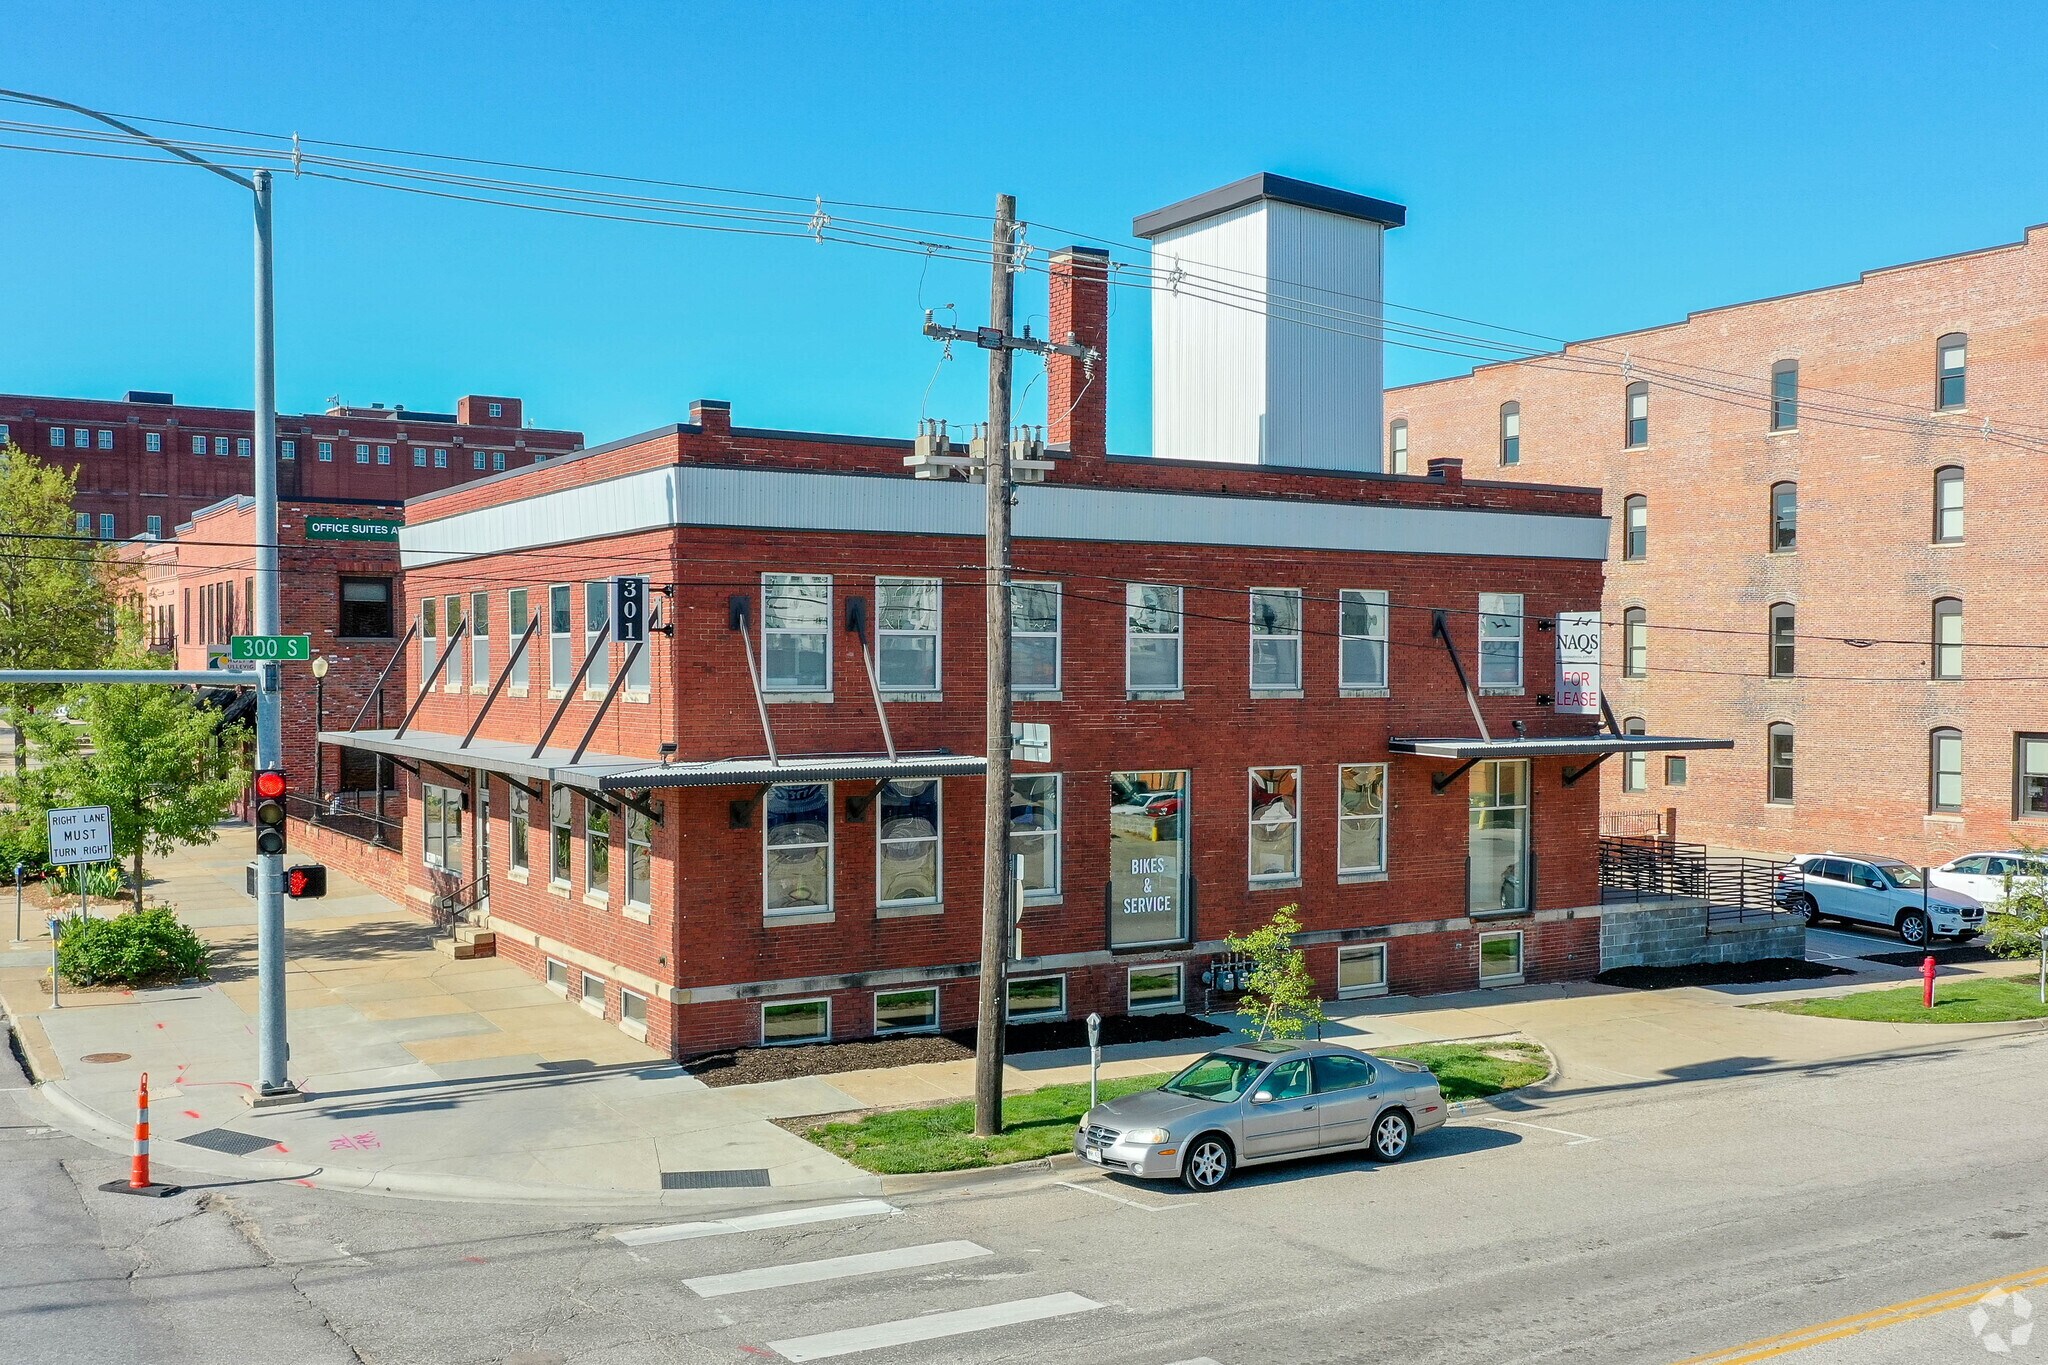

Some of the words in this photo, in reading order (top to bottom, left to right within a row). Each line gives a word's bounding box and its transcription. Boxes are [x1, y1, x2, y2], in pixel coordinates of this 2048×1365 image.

[312, 523, 350, 533] OFFICE
[352, 524, 388, 534] SUITES
[391, 526, 399, 535] A
[623, 580, 637, 639] 301
[243, 639, 278, 657] 300
[287, 639, 298, 657] S
[1556, 634, 1599, 655] NAQS
[1563, 672, 1590, 686] FOR
[1557, 692, 1597, 707] LEASE
[52, 816, 77, 826] RIGHT
[83, 813, 106, 823] LANE
[64, 829, 96, 841] MUST
[54, 847, 77, 857] TURN
[83, 845, 108, 855] RIGHT
[1131, 857, 1165, 875] BIKES
[1143, 877, 1152, 893] &
[1123, 895, 1171, 914] SERVICE
